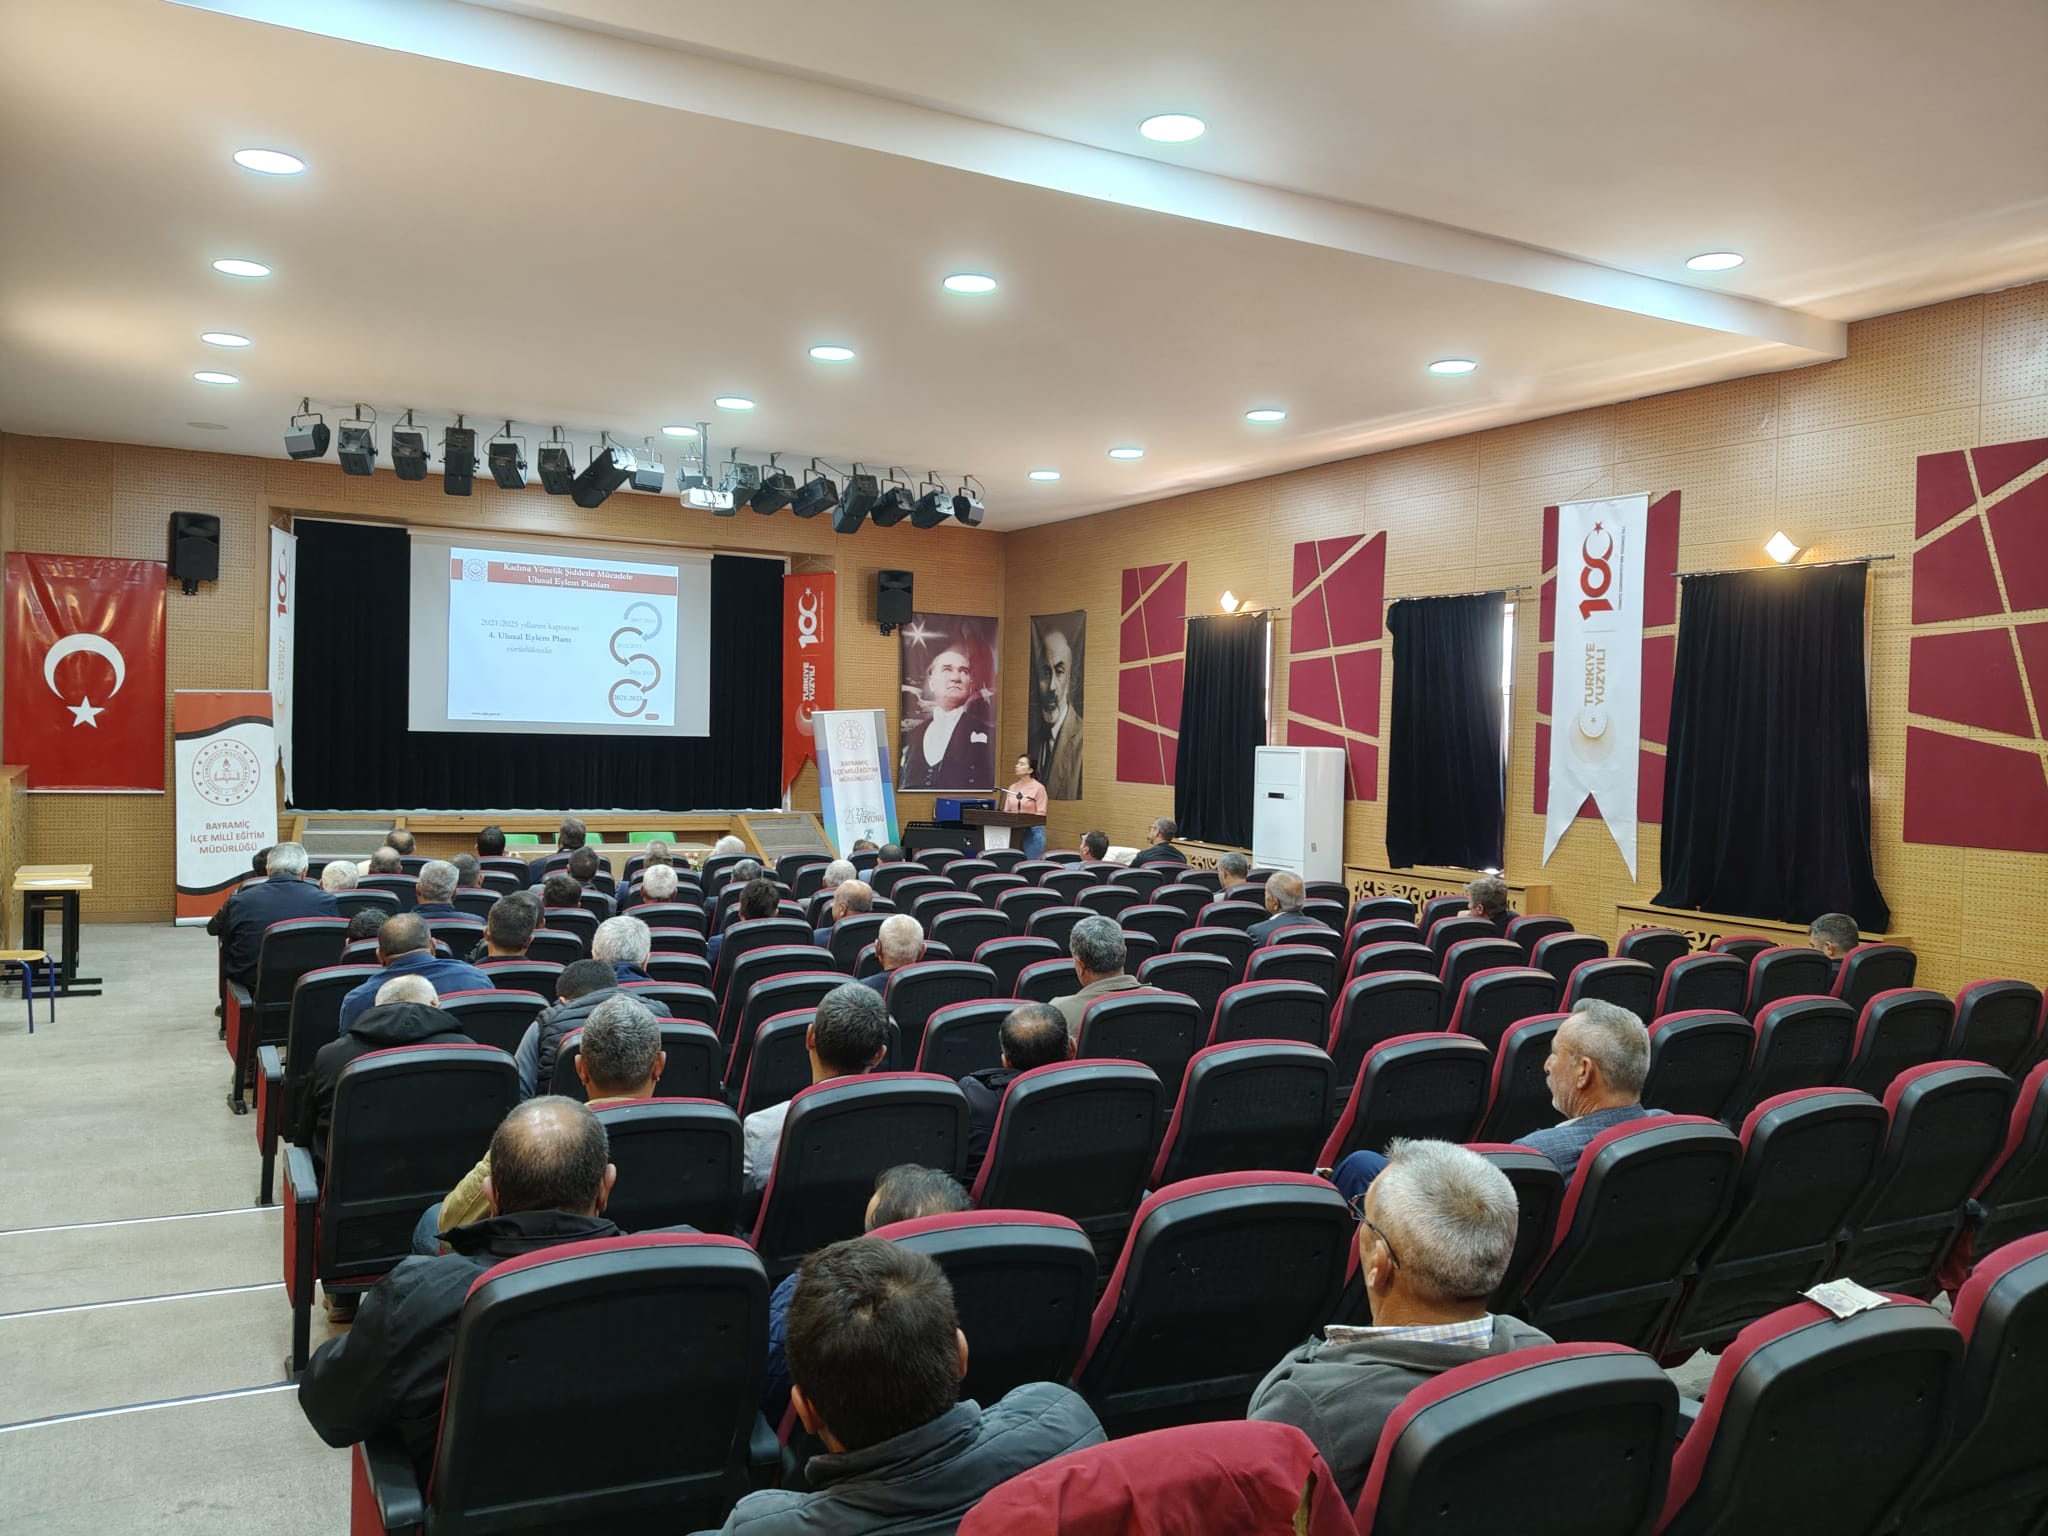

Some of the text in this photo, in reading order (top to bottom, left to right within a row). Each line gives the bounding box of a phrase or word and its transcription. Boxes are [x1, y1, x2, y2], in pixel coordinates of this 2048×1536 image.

[205, 818, 251, 831] BAYRAMİÇ
[190, 833, 209, 844] İLÇE
[235, 830, 265, 841] EĞİTİM
[199, 842, 258, 856] MÜDÜRLÜĞÜ
